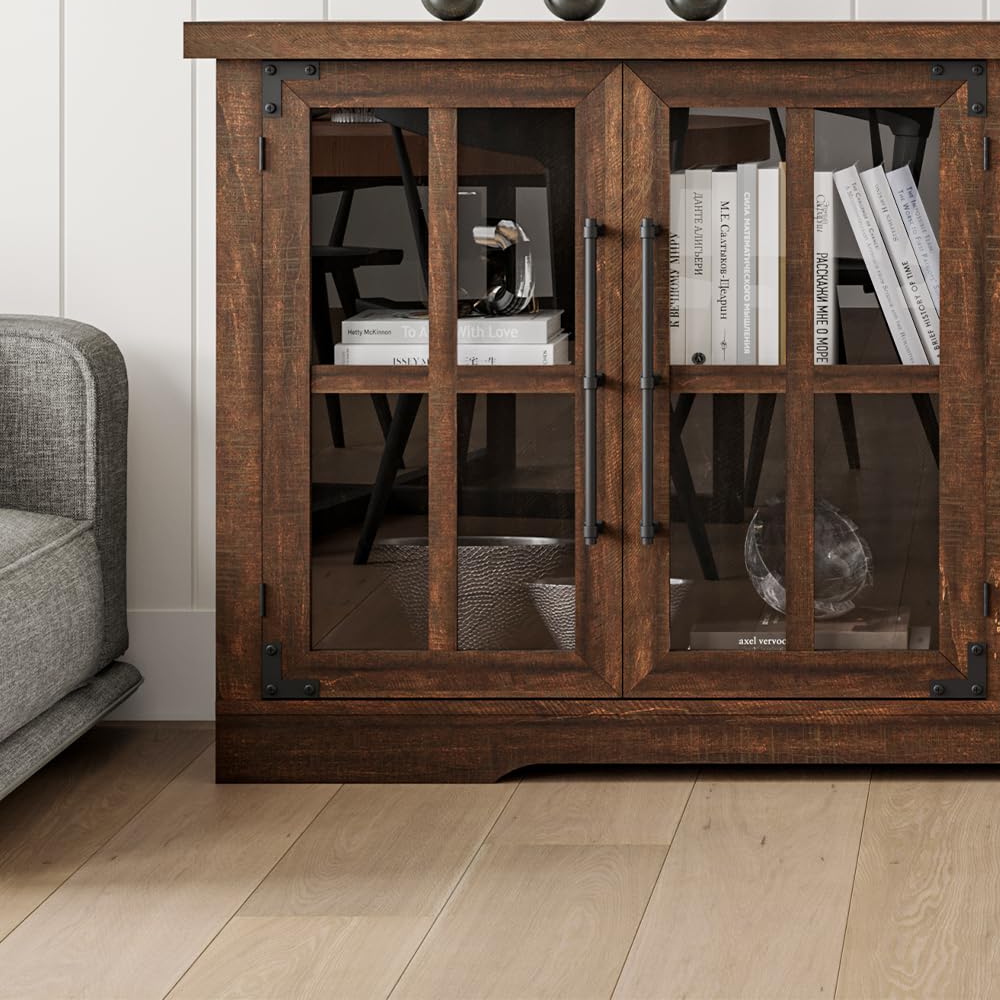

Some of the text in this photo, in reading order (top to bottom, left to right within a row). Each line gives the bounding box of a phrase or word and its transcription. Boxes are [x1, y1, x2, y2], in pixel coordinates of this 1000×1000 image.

[693, 192, 703, 276] ДАНТЕ АЛИГЬЕРИ
[717, 224, 730, 320] Салтыков-Щедрин
[743, 192, 751, 354] СИЛА МАТЕМАТИЧЕСКОГО МЫШЛЕНИЯ
[816, 252, 829, 302] РАССКАЖИ
[902, 261, 914, 280] TIME
[908, 279, 919, 293] OF
[816, 305, 829, 325] МНЕ
[914, 296, 932, 328] HISTORY
[347, 329, 363, 337] Hetty
[402, 326, 416, 338] To
[489, 326, 519, 338] Love
[926, 330, 939, 351] BRIEF
[816, 338, 829, 363] МОРЕ
[738, 636, 757, 645] axel
